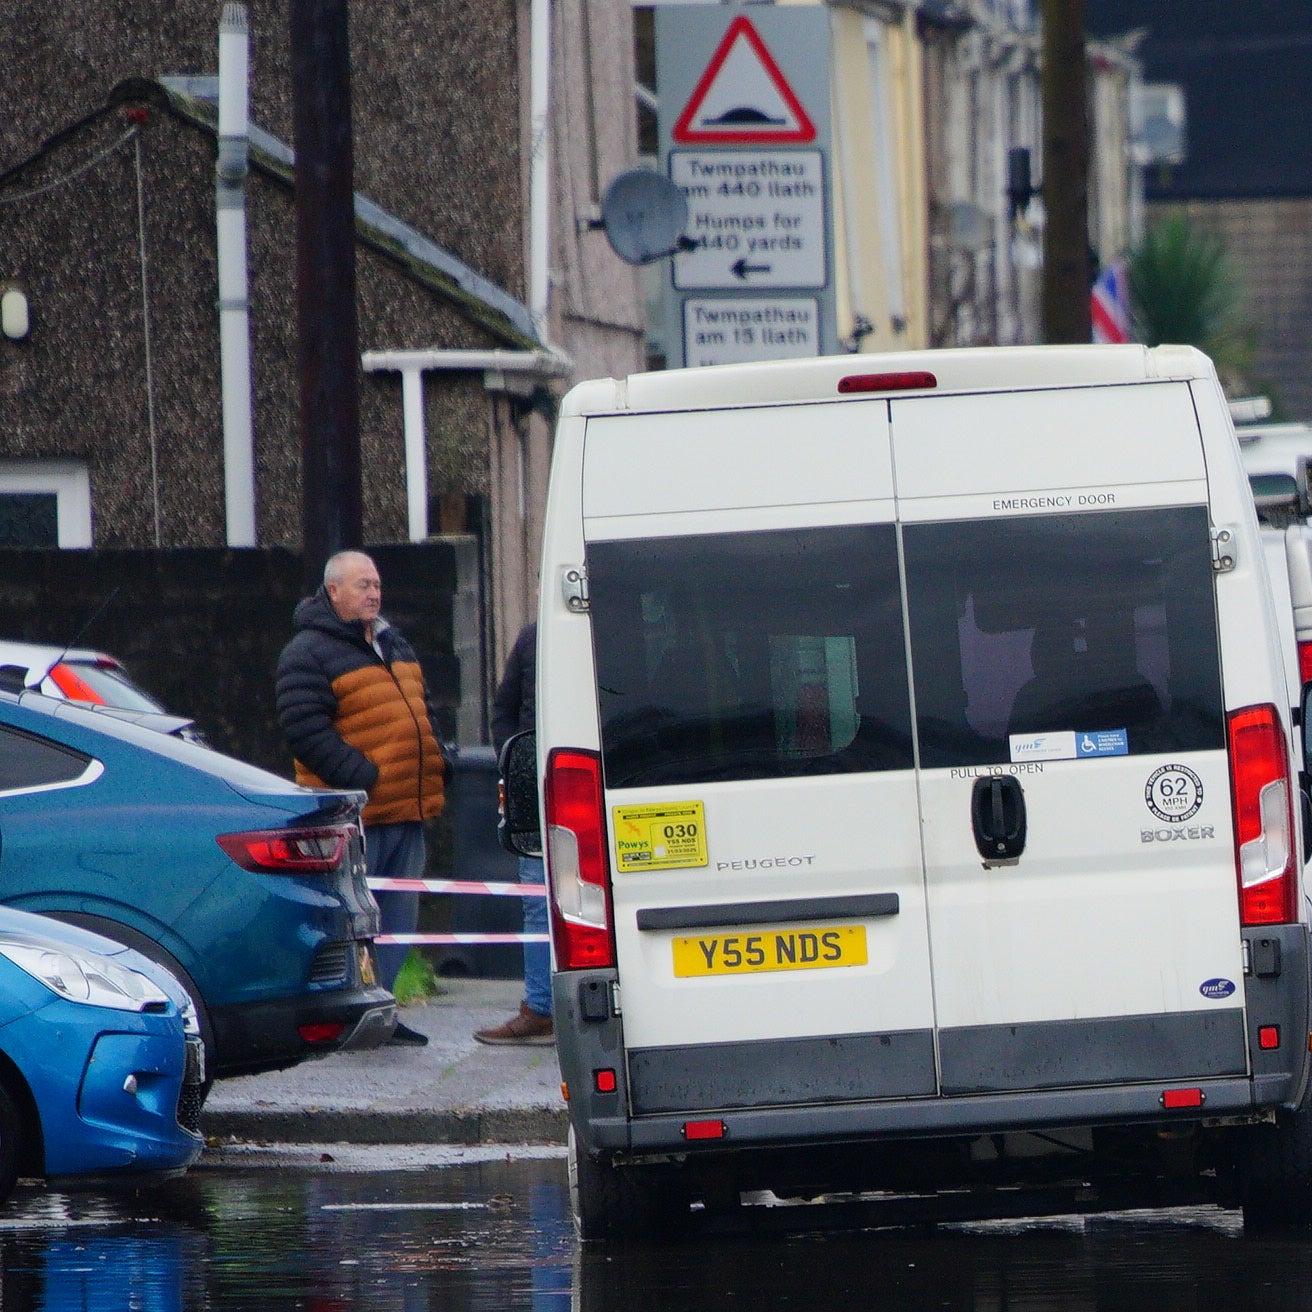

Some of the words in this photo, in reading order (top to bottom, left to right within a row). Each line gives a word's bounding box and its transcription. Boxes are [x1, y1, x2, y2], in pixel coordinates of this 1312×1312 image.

[688, 160, 804, 177] Twmpathau
[717, 182, 760, 197] 440
[768, 182, 814, 197] llath
[696, 213, 765, 231] Humps
[773, 212, 801, 229] for
[747, 234, 802, 253] yards
[694, 307, 809, 324] Twmpathau
[695, 333, 723, 345] am
[734, 328, 753, 345] 15
[761, 328, 807, 345] llath
[993, 495, 1073, 511] EMERGENCY
[1078, 493, 1116, 506] DOOR
[950, 767, 979, 779] PULL
[986, 765, 1003, 776] TO
[1008, 763, 1044, 775] OPEN
[1160, 777, 1188, 797] 62
[1162, 797, 1188, 806] MPH
[664, 823, 698, 839] 030
[1140, 824, 1216, 844] BOXER
[618, 840, 649, 850] Powys
[716, 854, 816, 872] PEUGEOT
[699, 937, 765, 969] Y55
[775, 932, 842, 964] NDS
